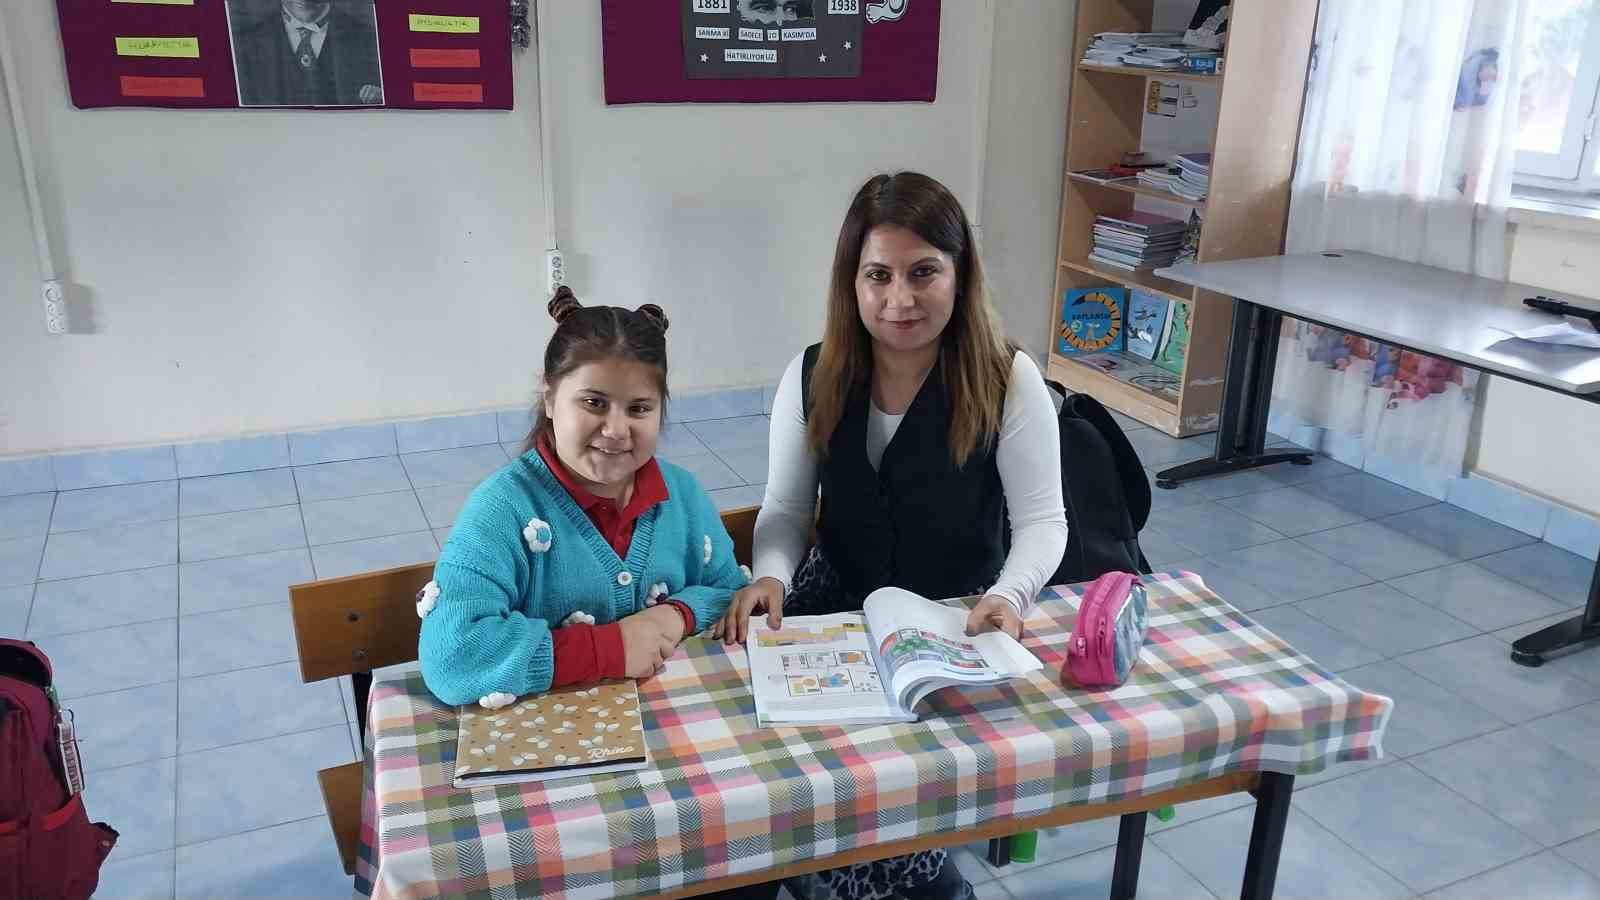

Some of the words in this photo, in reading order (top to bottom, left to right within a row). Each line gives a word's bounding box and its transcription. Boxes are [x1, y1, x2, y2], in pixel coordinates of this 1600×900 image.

[697, 0, 728, 9] 1881
[831, 0, 857, 11] 1938
[740, 30, 762, 39] SADECE
[783, 31, 815, 39] KASIM'DA
[587, 745, 634, 759] Rhino
